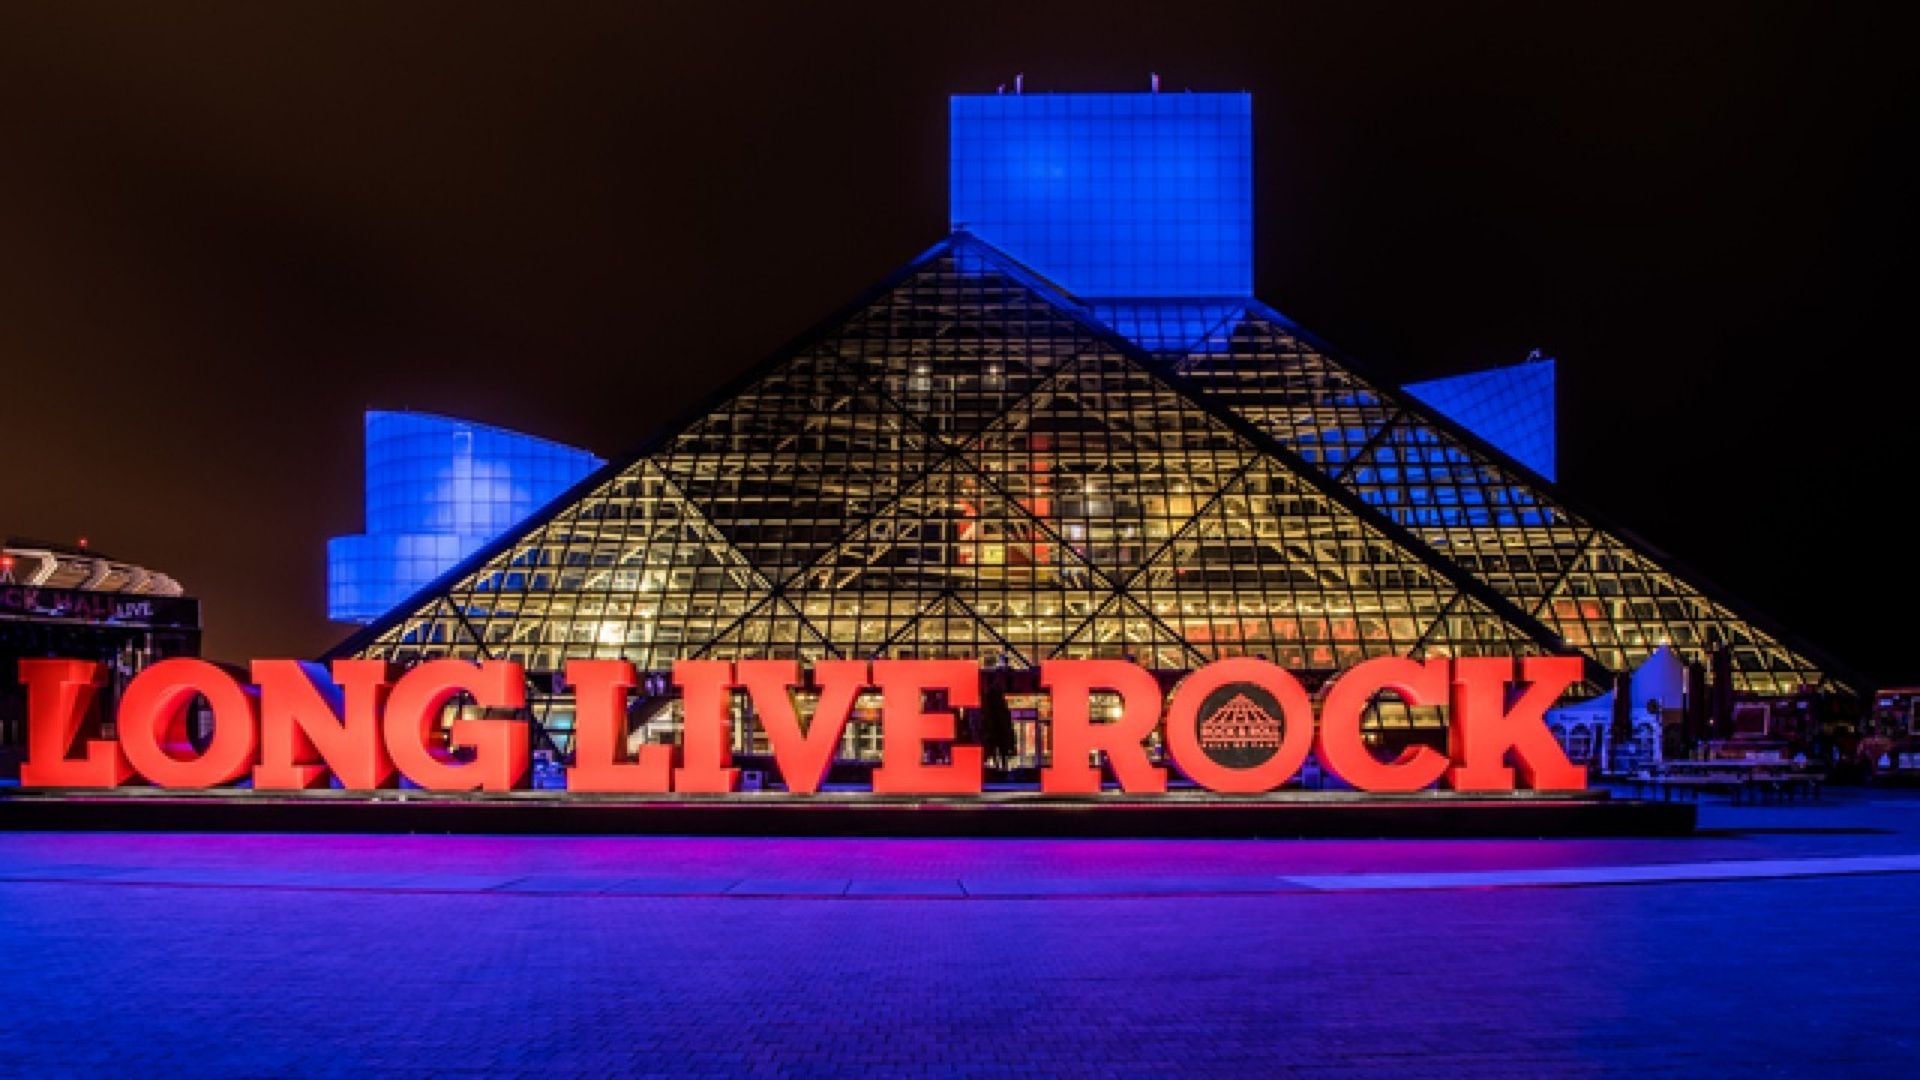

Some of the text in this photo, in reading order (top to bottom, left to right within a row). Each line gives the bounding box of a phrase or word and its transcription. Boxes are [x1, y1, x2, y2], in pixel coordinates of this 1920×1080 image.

[18, 656, 1587, 793] LONG LIVE ROCK
